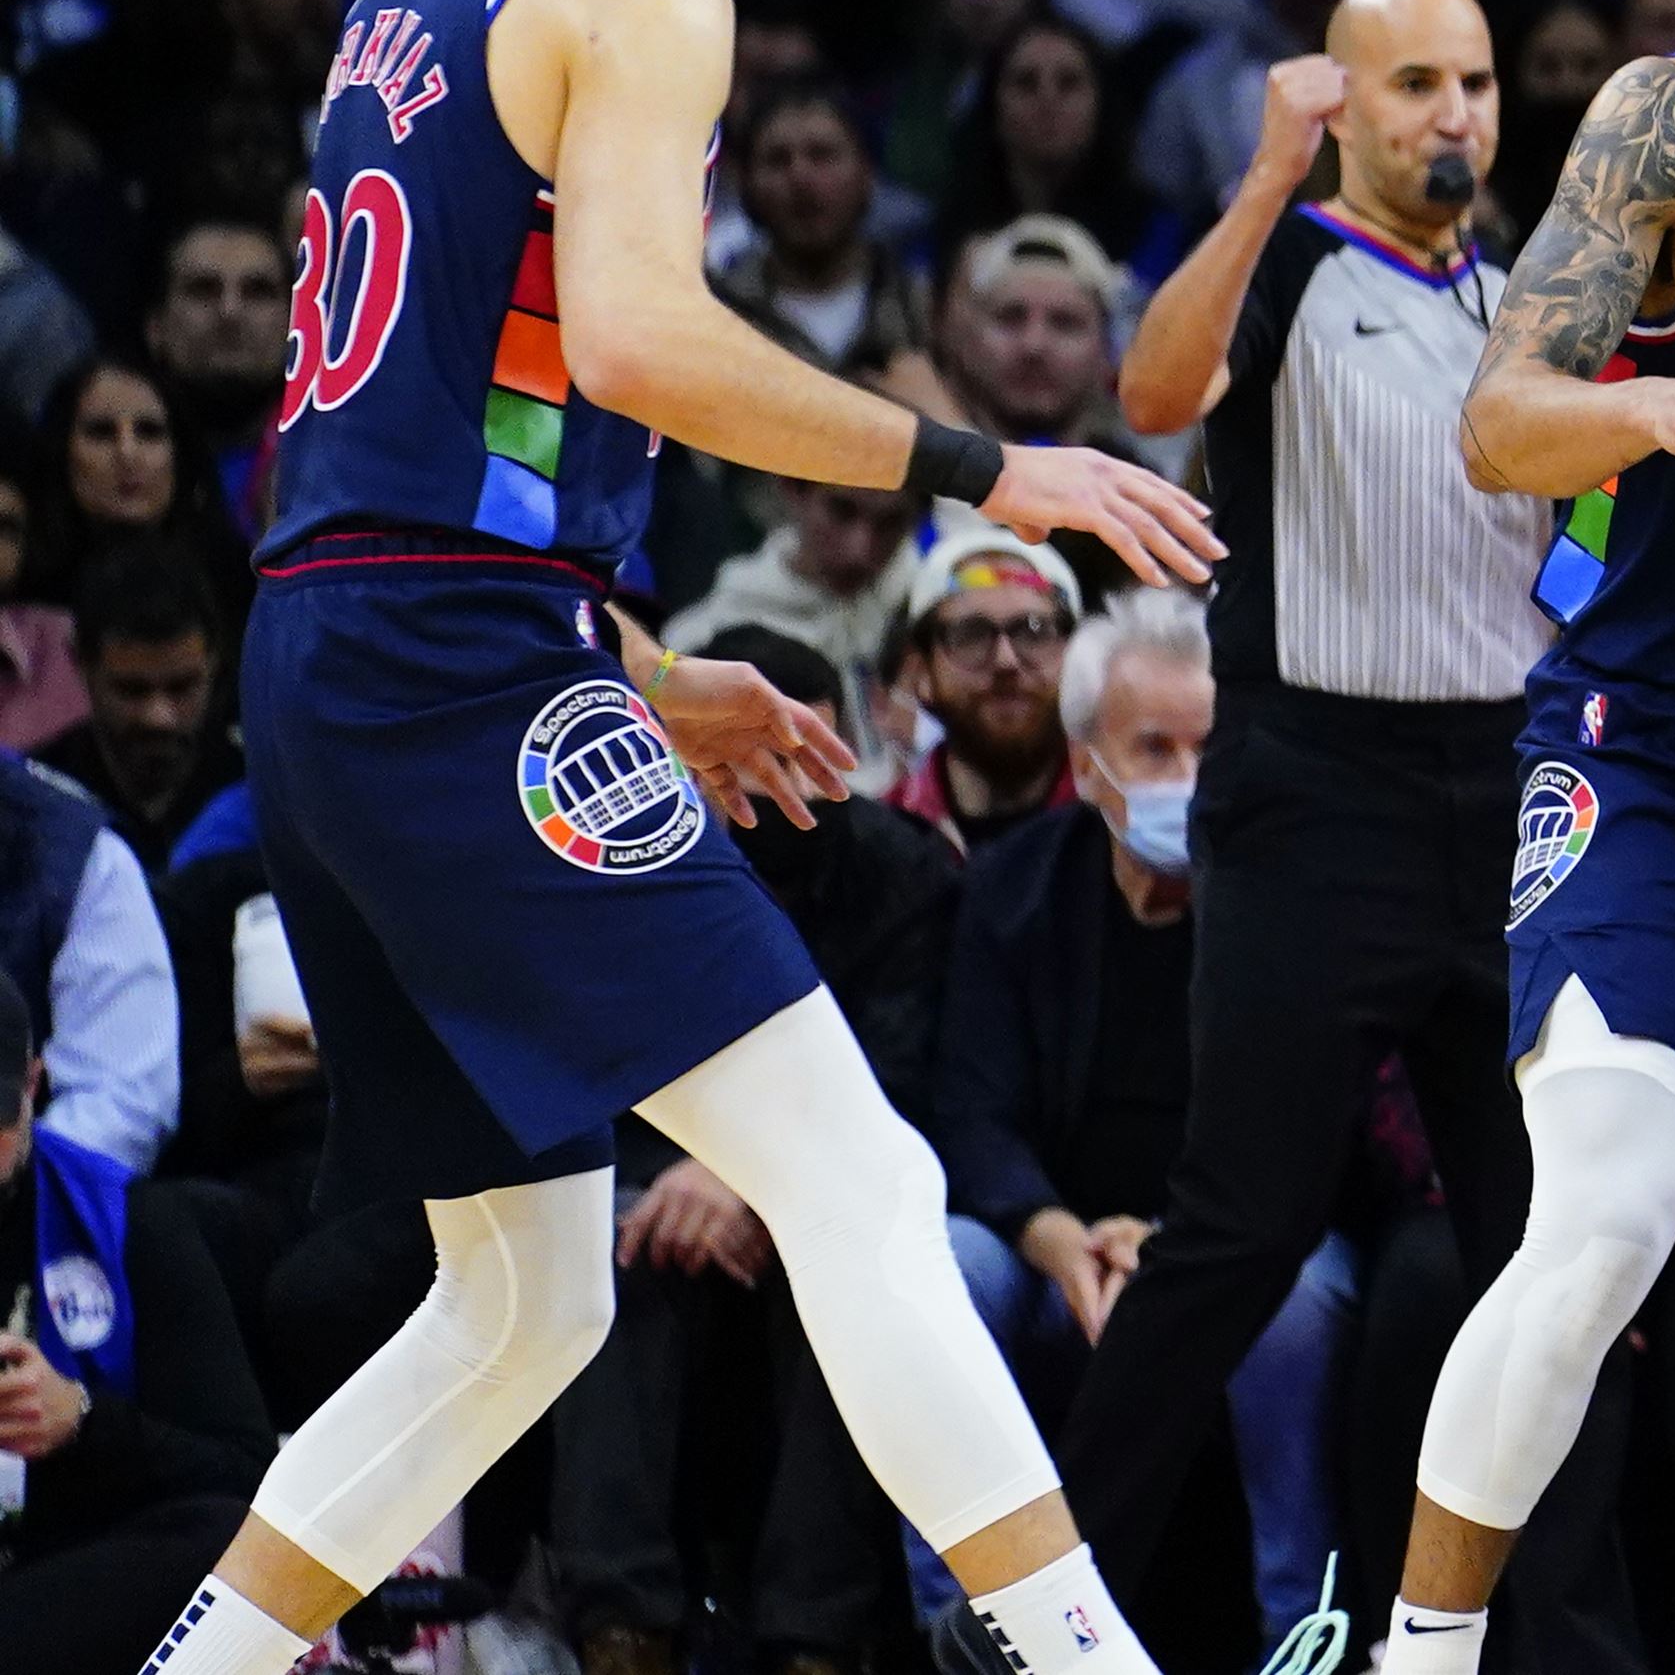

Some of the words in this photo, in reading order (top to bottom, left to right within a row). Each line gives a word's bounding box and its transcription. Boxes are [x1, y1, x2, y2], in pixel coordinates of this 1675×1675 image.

[279, 168, 412, 433] 30
[533, 689, 624, 746] Spectrum
[610, 809, 698, 864] Spectrum
